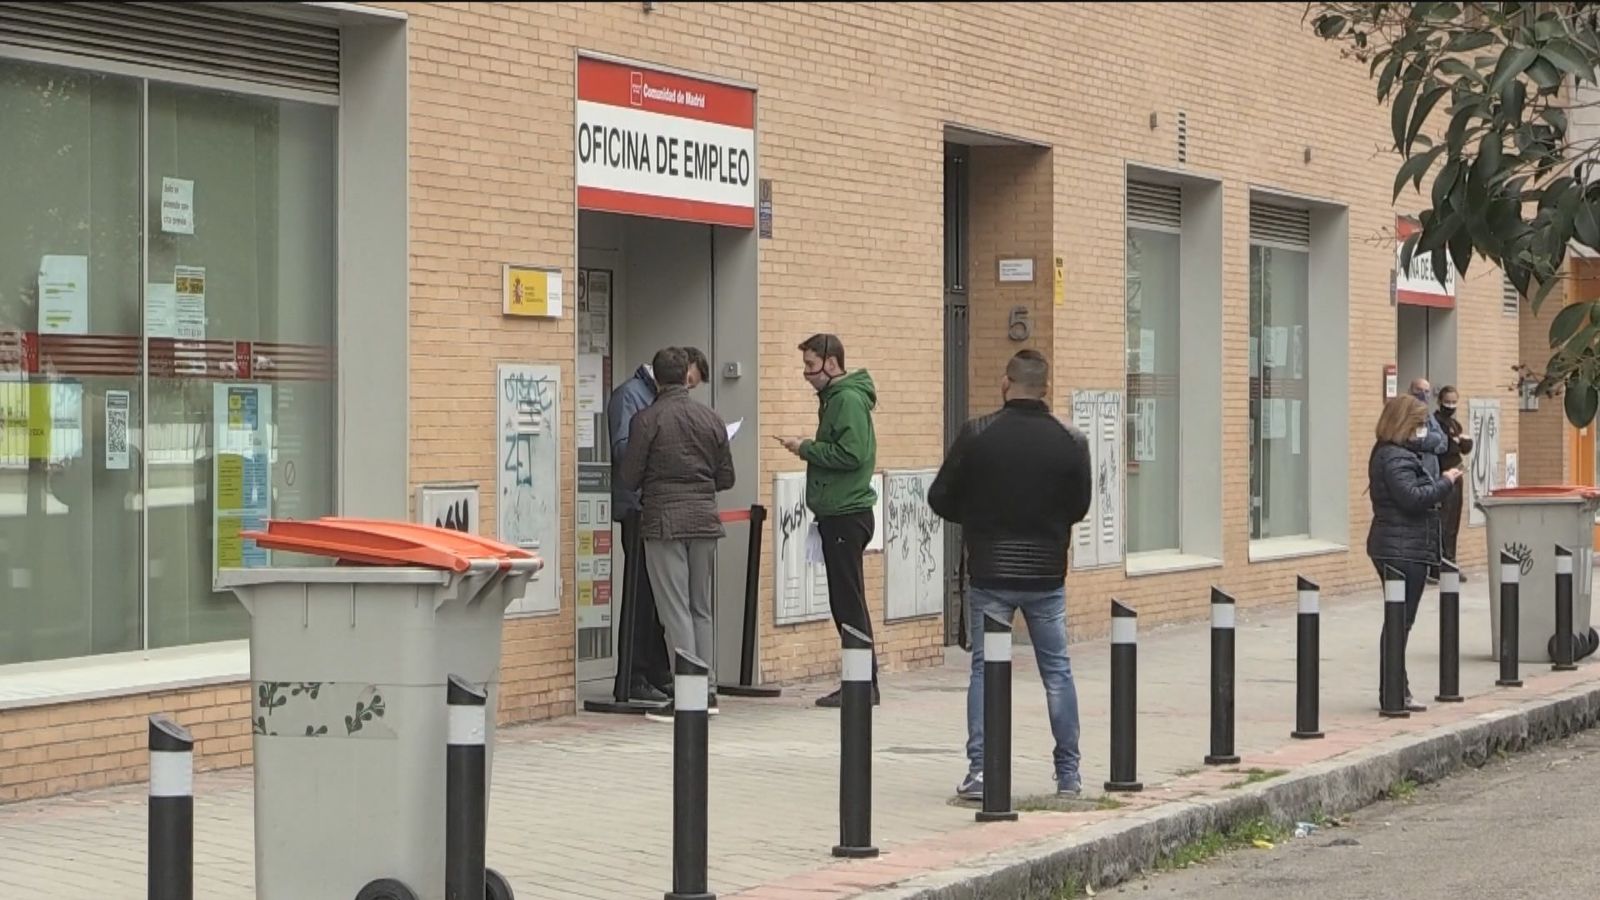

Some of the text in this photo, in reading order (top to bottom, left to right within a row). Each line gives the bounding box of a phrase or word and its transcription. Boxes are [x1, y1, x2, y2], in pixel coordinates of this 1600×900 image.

[643, 83, 676, 104] Comunidad
[677, 90, 685, 104] de
[686, 91, 705, 109] Madrid
[578, 122, 750, 187] OFICINA DE EMPLEO
[1008, 305, 1030, 342] 5
